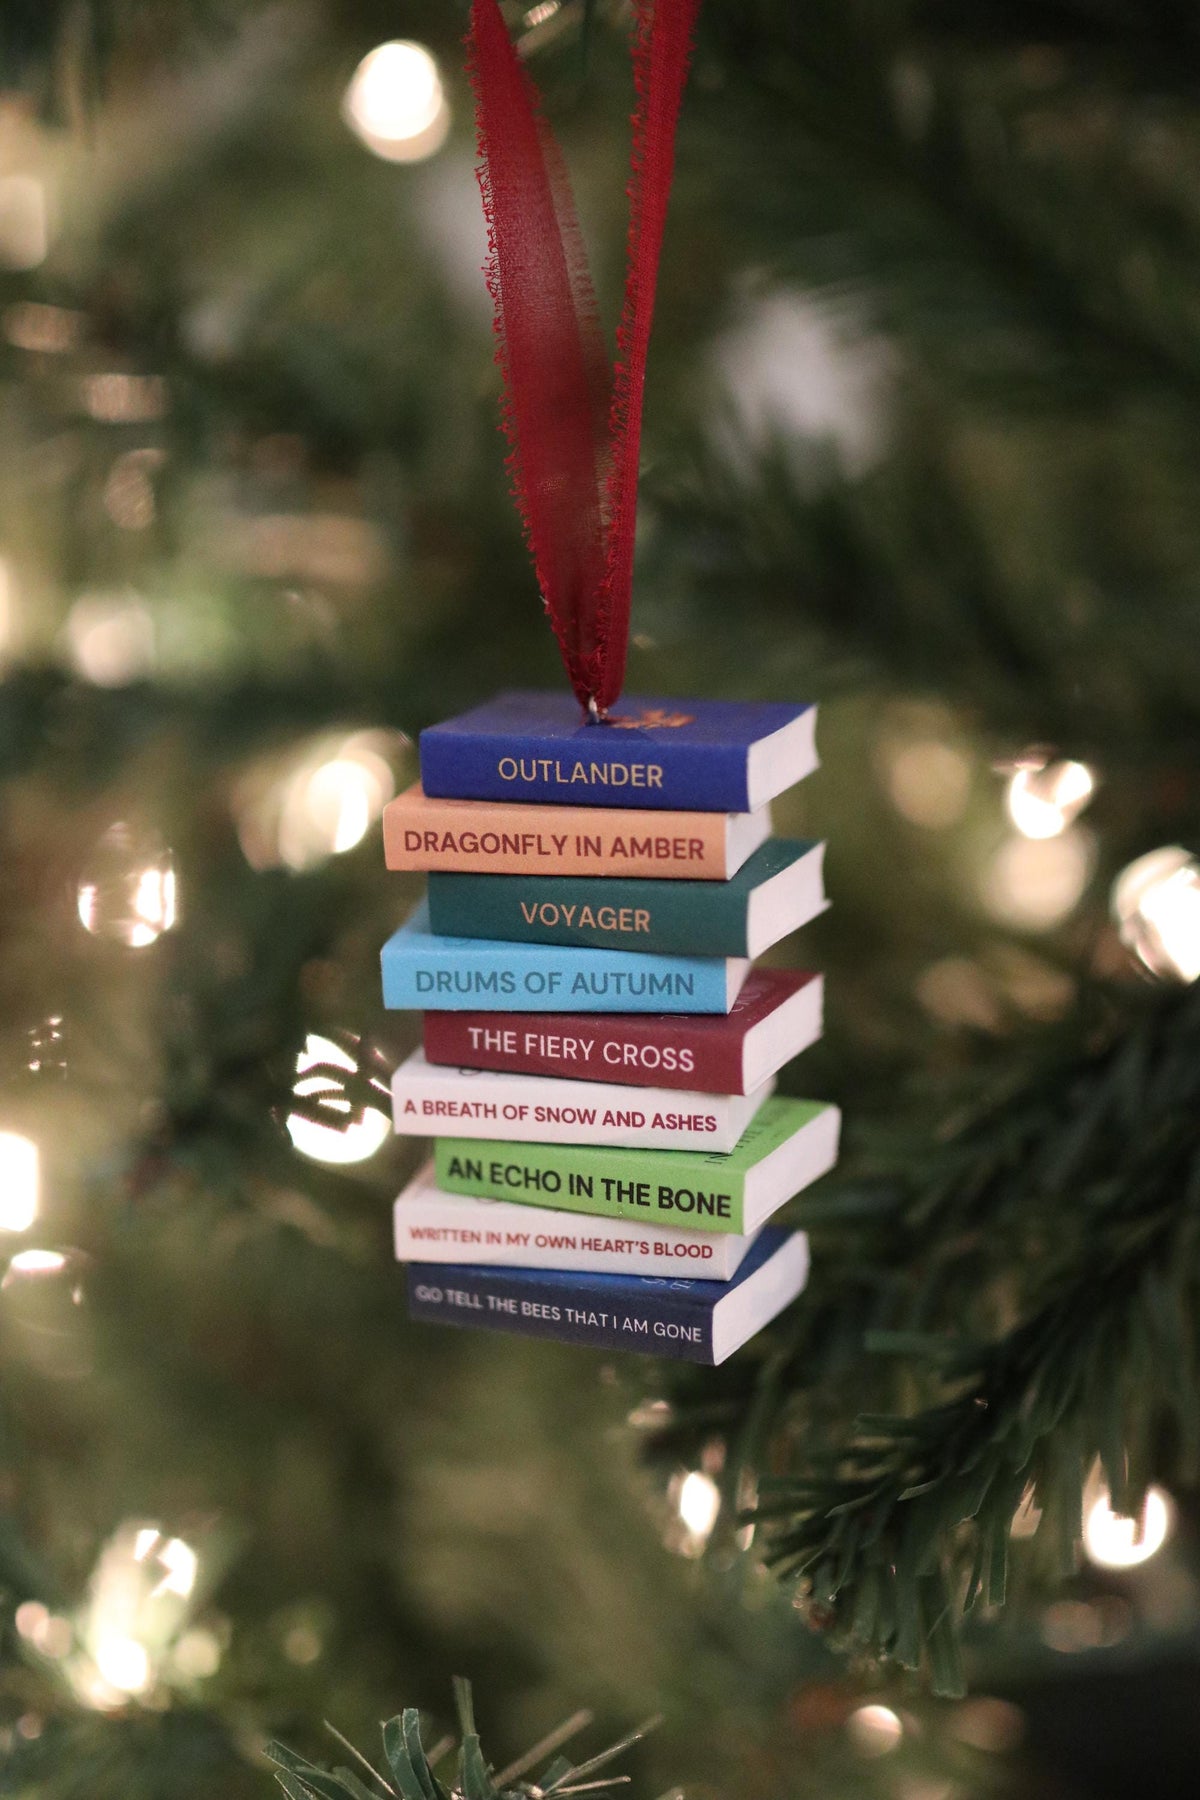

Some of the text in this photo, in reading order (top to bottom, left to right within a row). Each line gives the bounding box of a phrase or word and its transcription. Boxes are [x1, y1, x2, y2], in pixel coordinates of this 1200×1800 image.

[499, 757, 663, 788] OUTLANDER
[404, 830, 704, 860] DRAGONFLY IN AMBER
[521, 902, 650, 933] VOYAGER
[416, 971, 694, 996] DRUMS OF AUTUMN
[468, 1028, 695, 1072] THE FIERY CROSS
[403, 1099, 717, 1132] A BREATH OF SNOW AND ASHES
[448, 1157, 732, 1218] AN ECHO IN THE BONE
[409, 1226, 713, 1259] WRITTEN IN MY OWN HEART'S BLOOD
[415, 1284, 703, 1343] GO TELL THE BEES THAT I AM GONE
